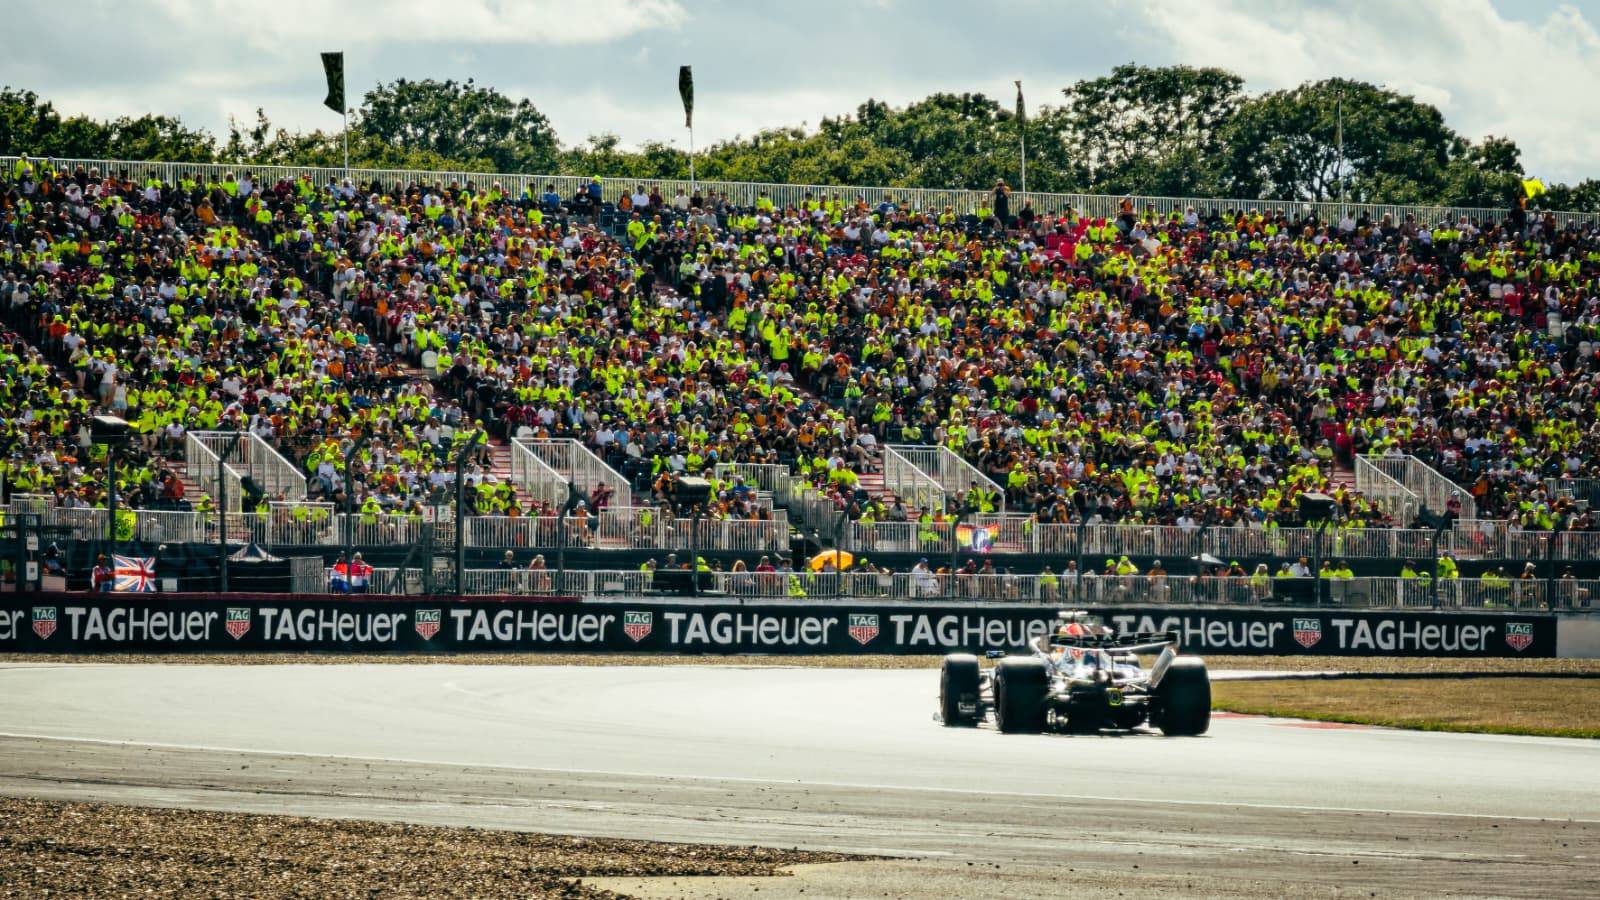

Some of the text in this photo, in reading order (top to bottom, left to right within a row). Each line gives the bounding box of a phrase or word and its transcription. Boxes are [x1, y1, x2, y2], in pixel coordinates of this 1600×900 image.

[34, 608, 56, 620] TAG
[228, 609, 250, 621] TAG
[416, 611, 440, 622] TAG
[626, 613, 650, 624] TAG
[851, 616, 877, 626] TAG
[1295, 620, 1319, 630] TAG
[1509, 624, 1530, 634] TAG
[849, 627, 880, 643] HEUER
